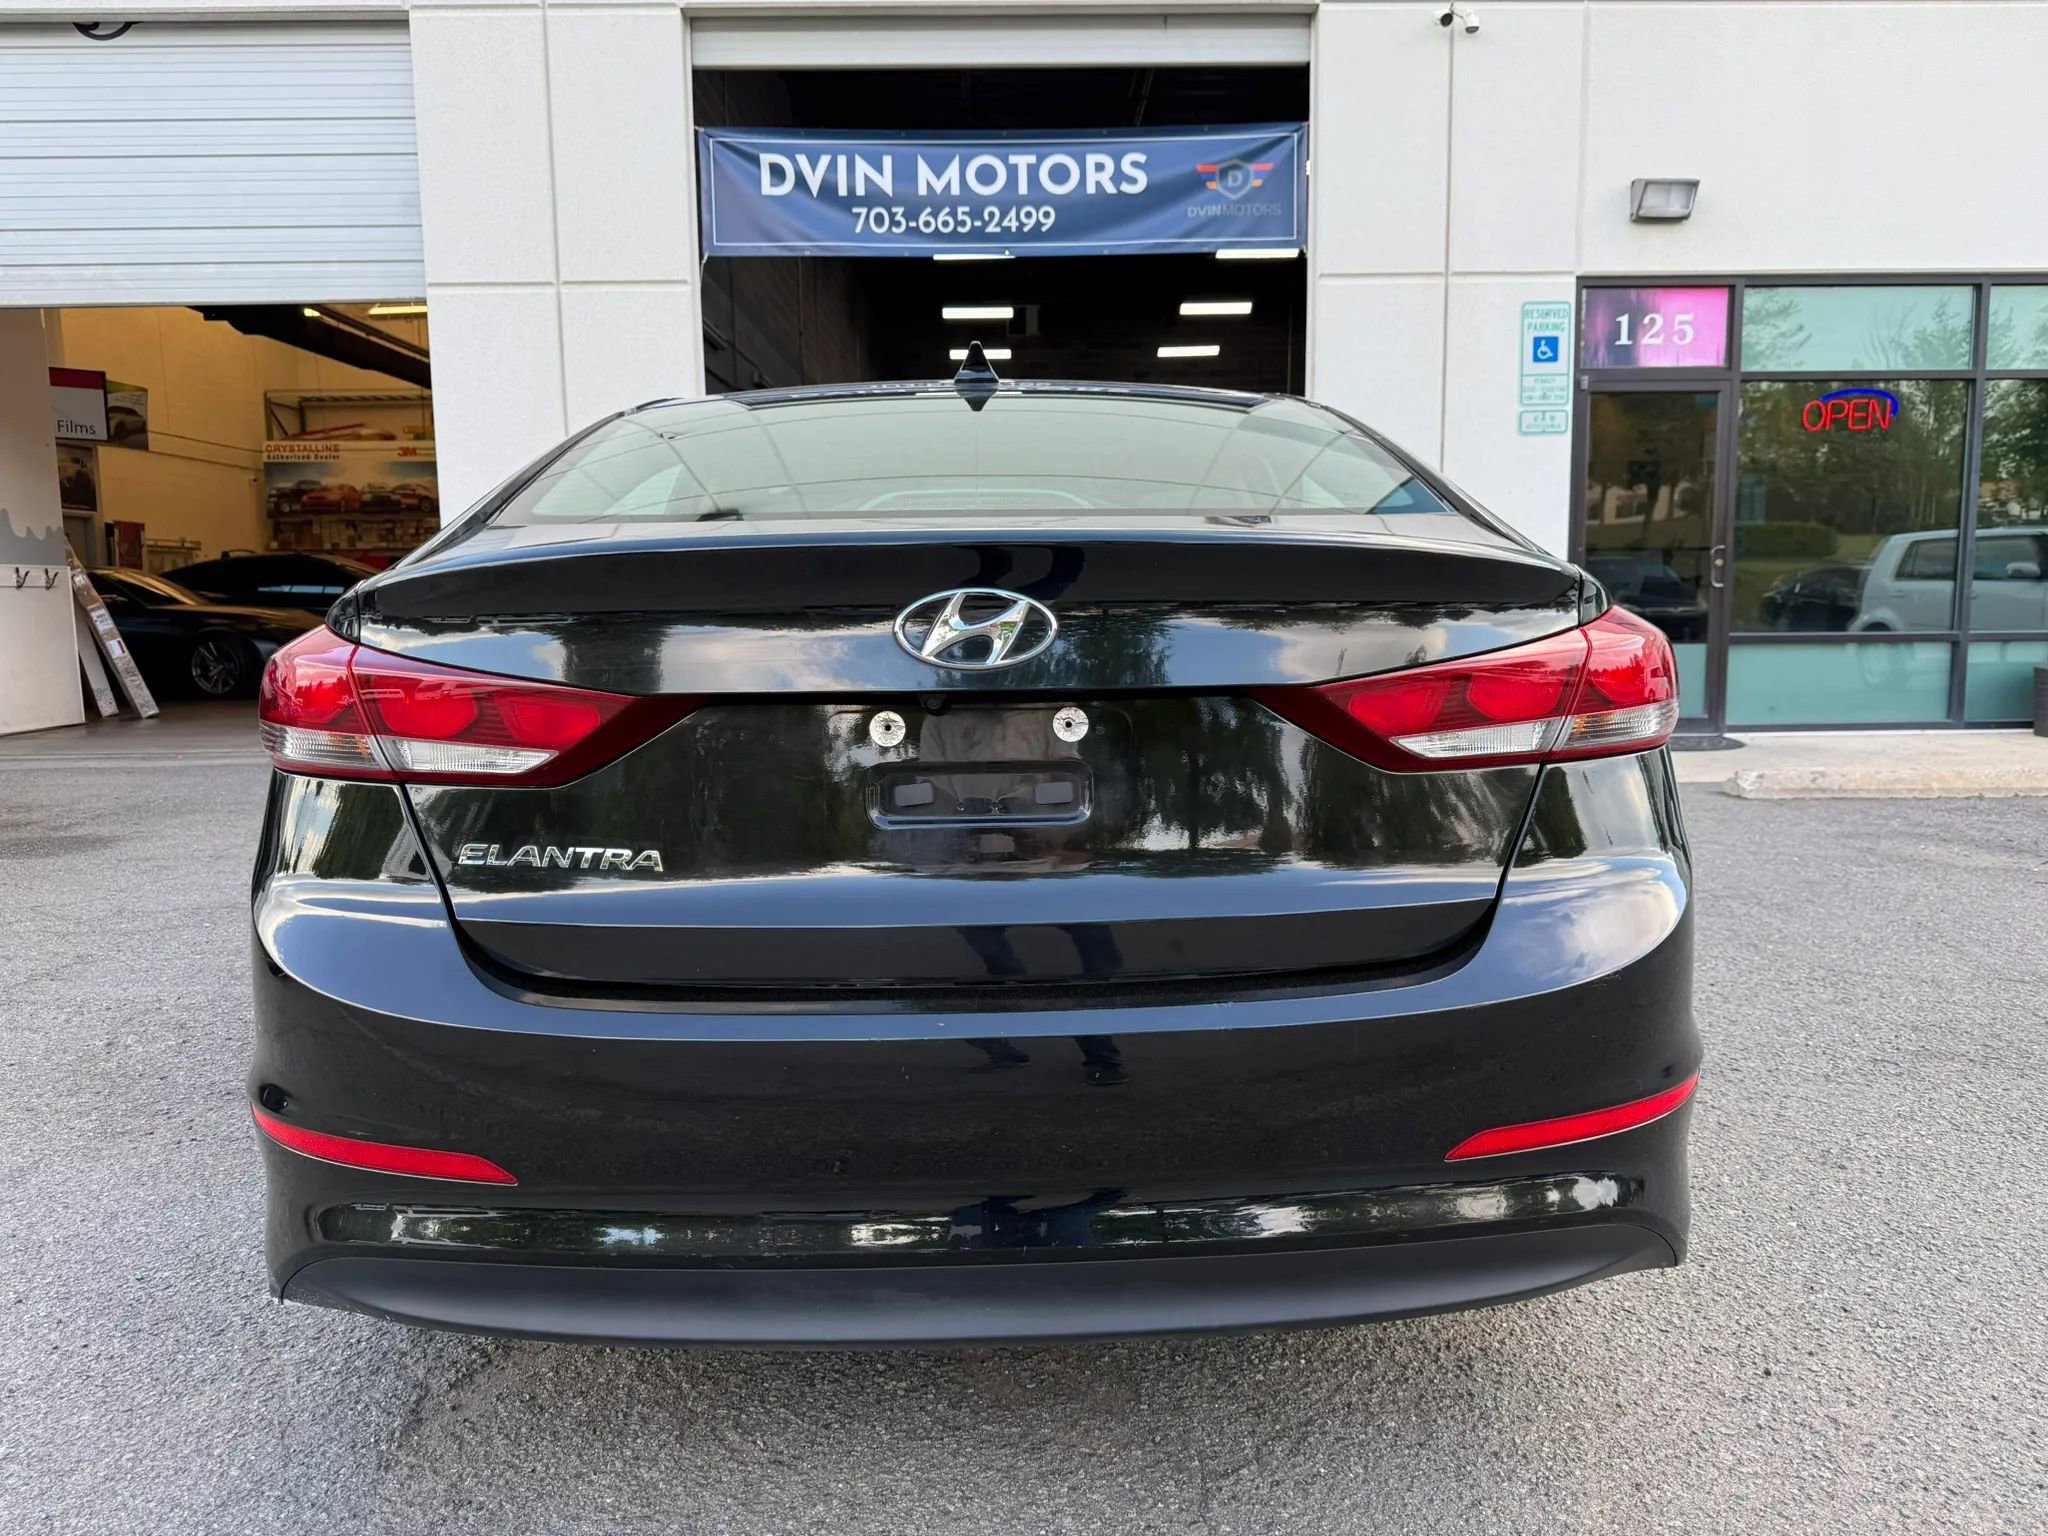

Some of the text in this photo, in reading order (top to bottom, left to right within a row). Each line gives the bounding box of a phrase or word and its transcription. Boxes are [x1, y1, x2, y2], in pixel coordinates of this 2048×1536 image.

[758, 152, 1149, 198] DVIN MOTORS
[851, 205, 1056, 234] 703-665-2499
[1187, 203, 1282, 217] DVINMOTORS
[1614, 313, 1695, 346] 125
[57, 419, 97, 435] Films
[1802, 399, 1891, 432] OPEN
[458, 843, 664, 872] ELANTRA
